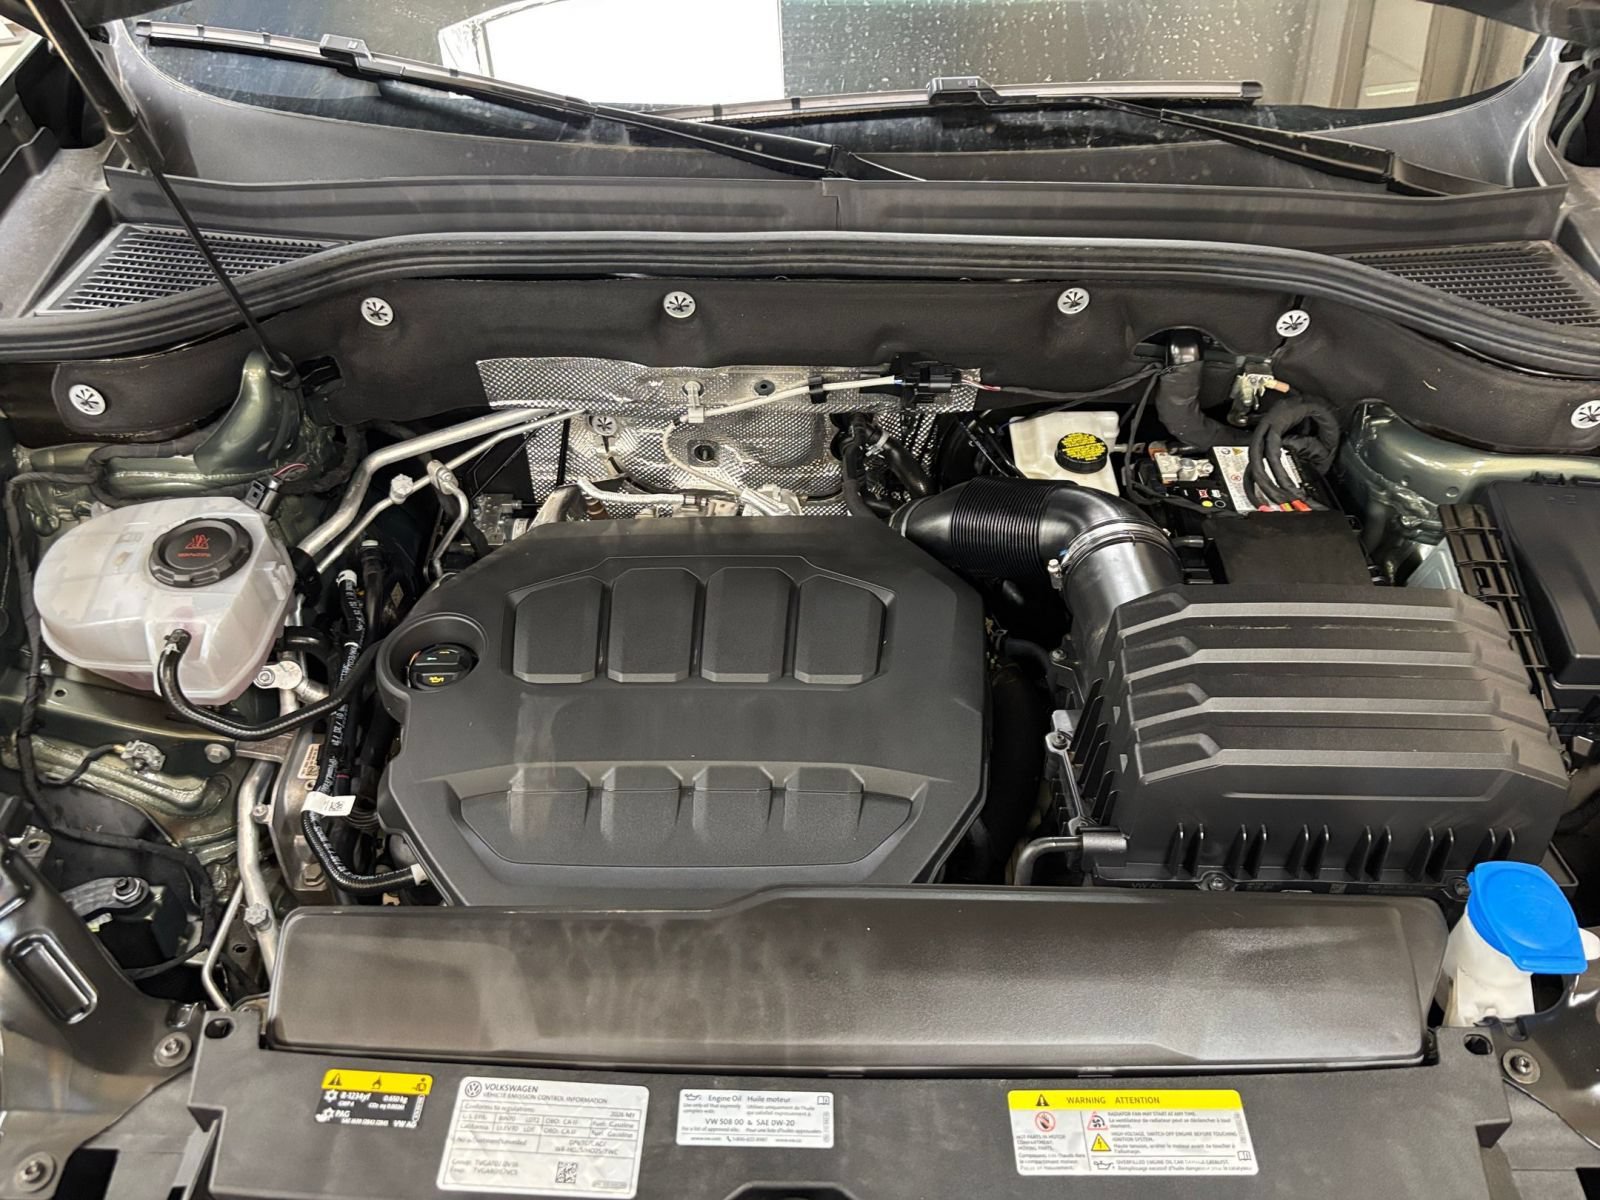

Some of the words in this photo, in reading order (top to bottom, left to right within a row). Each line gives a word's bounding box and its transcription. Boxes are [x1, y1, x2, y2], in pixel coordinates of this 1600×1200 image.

[484, 1083, 539, 1093] VOLKSWAGEN
[566, 1096, 608, 1104] INFORMATION
[708, 1095, 731, 1103] Engine
[1066, 1096, 1106, 1104] WARNING
[1115, 1096, 1161, 1104] ATTENTION
[335, 1109, 351, 1118] PAG
[393, 1120, 405, 1128] VW
[720, 1118, 733, 1126] 508
[734, 1118, 745, 1126] 00
[771, 1119, 796, 1127] 0W-20
